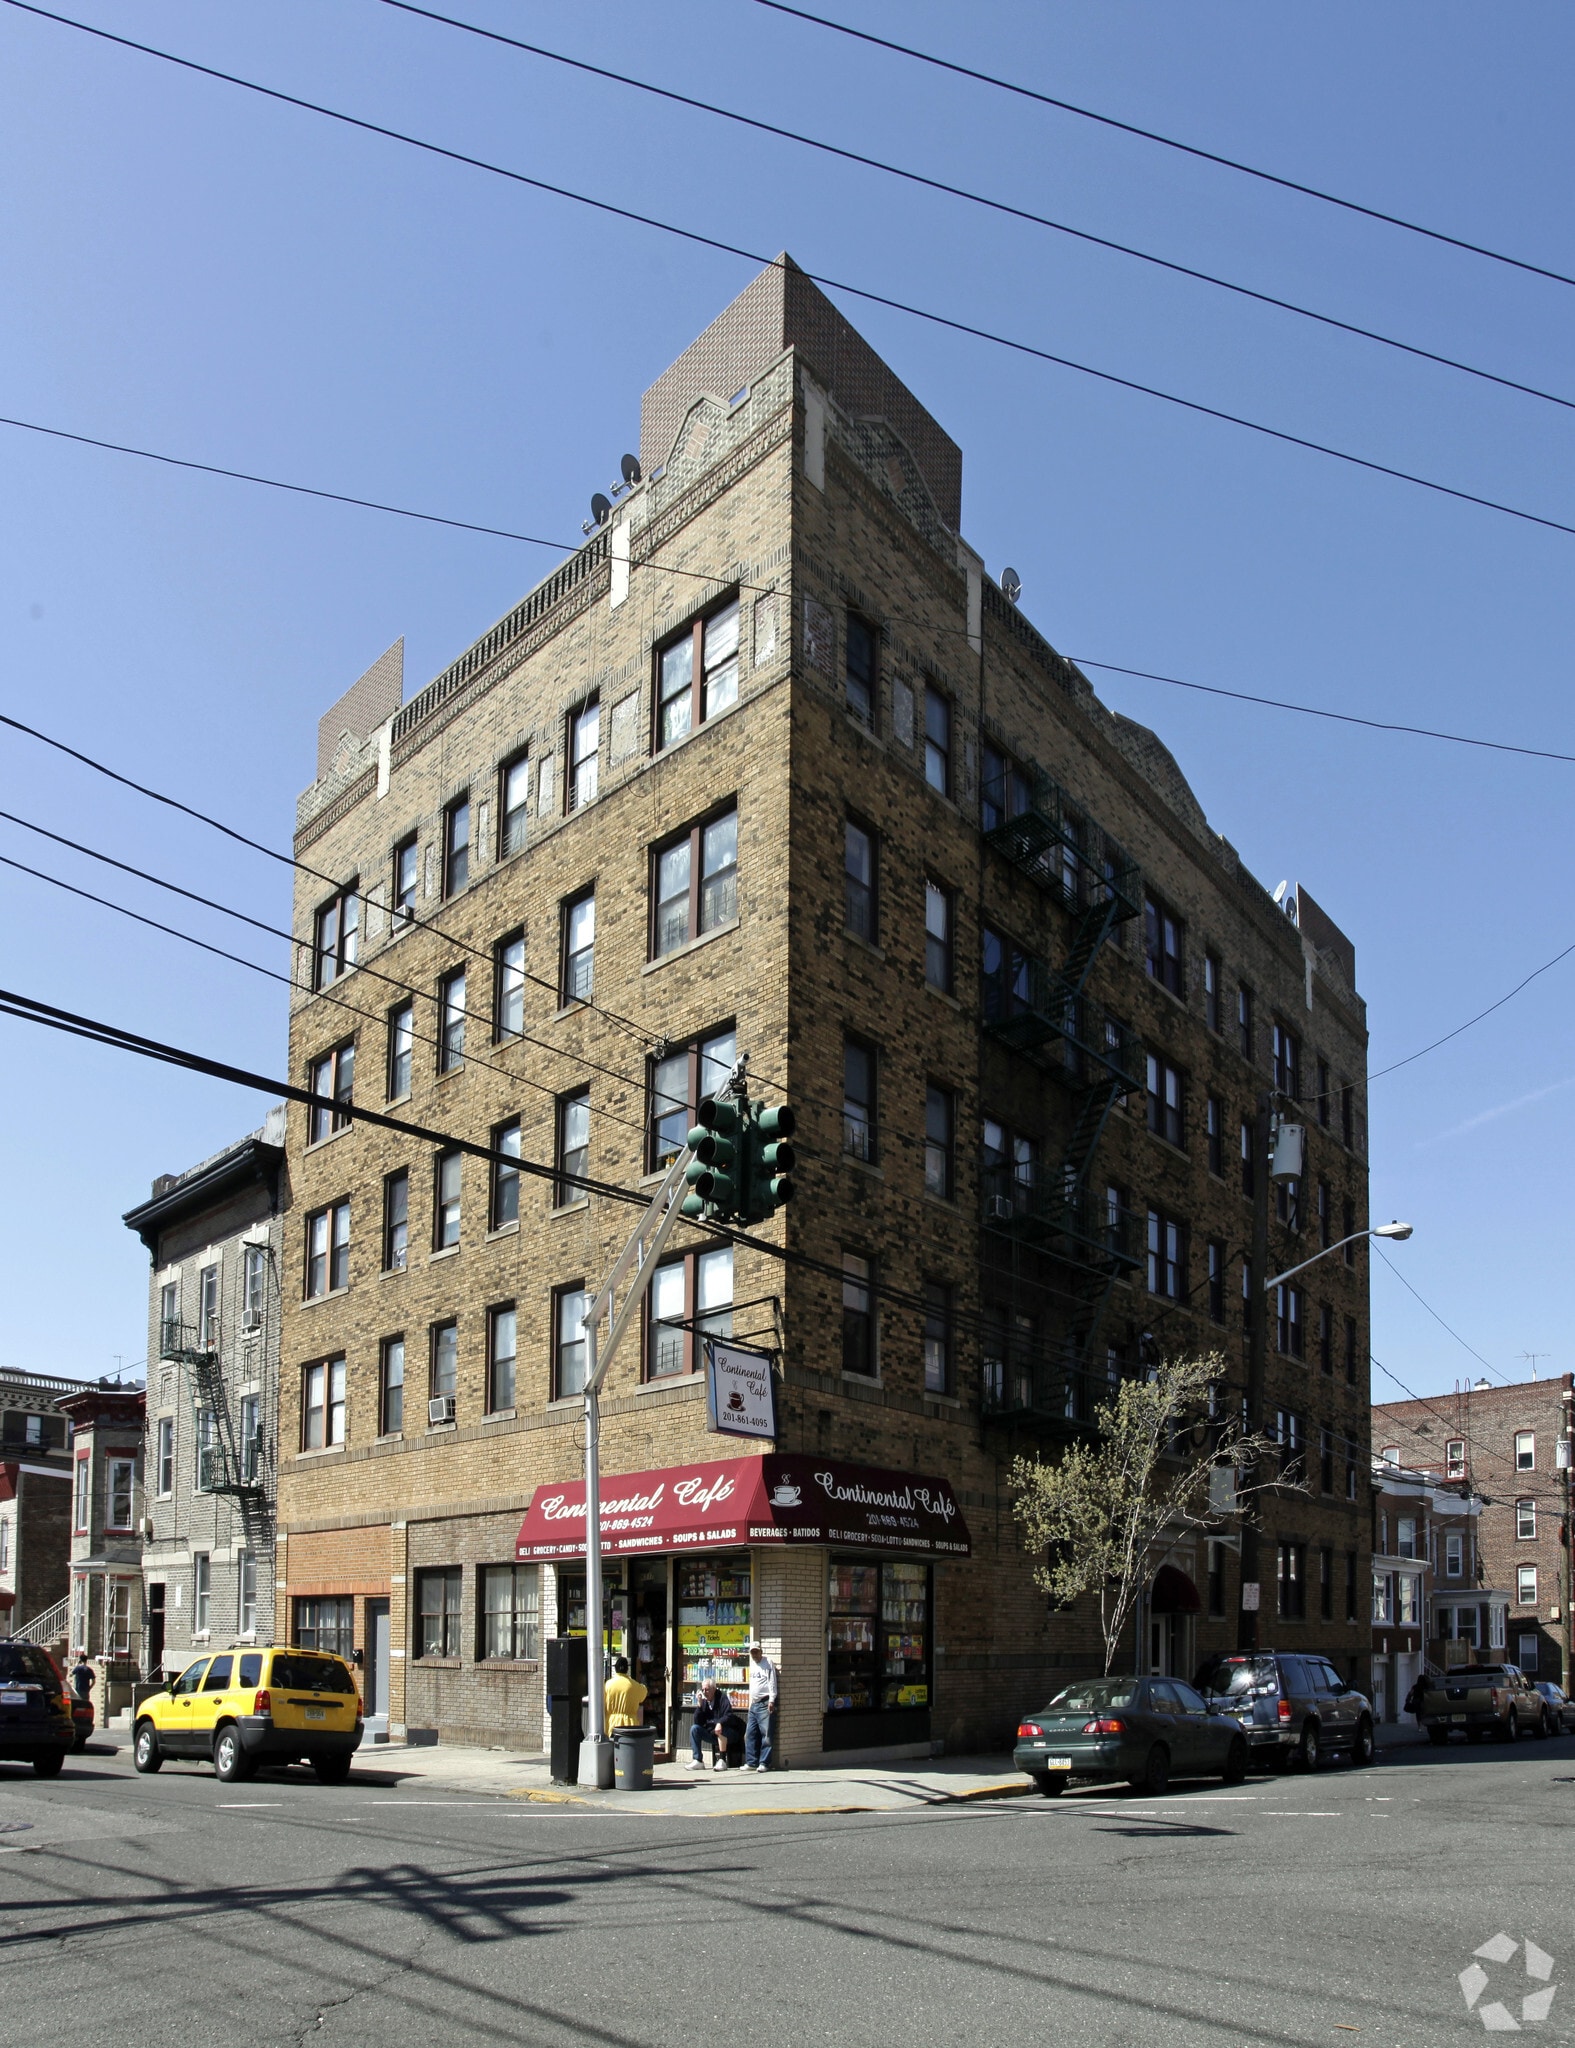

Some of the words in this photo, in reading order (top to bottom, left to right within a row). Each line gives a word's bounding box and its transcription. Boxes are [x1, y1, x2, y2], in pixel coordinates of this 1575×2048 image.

[718, 1357, 767, 1381] Continental
[747, 1381, 768, 1401] Café
[723, 1412, 768, 1428] 201-861-4095
[541, 1482, 665, 1521] Contnental
[673, 1474, 735, 1512] Café
[814, 1472, 916, 1511] Continental
[914, 1488, 956, 1523] Café
[519, 1546, 531, 1556] DELI
[533, 1544, 556, 1555] GROCERY
[559, 1543, 576, 1554] CANDY
[600, 1541, 612, 1550] TTO
[618, 1535, 663, 1549] SANDWICHES
[672, 1531, 698, 1543] SOUPS
[699, 1531, 705, 1541] &
[706, 1528, 737, 1540] SALADS
[750, 1527, 788, 1538] BEVERAGES
[792, 1527, 821, 1537] BATIDOS
[828, 1528, 843, 1540] DELI
[843, 1530, 868, 1542] GROCERY
[903, 1537, 931, 1549] SANDWICHES
[935, 1541, 949, 1551] SOUPS
[953, 1543, 968, 1553] SALADS
